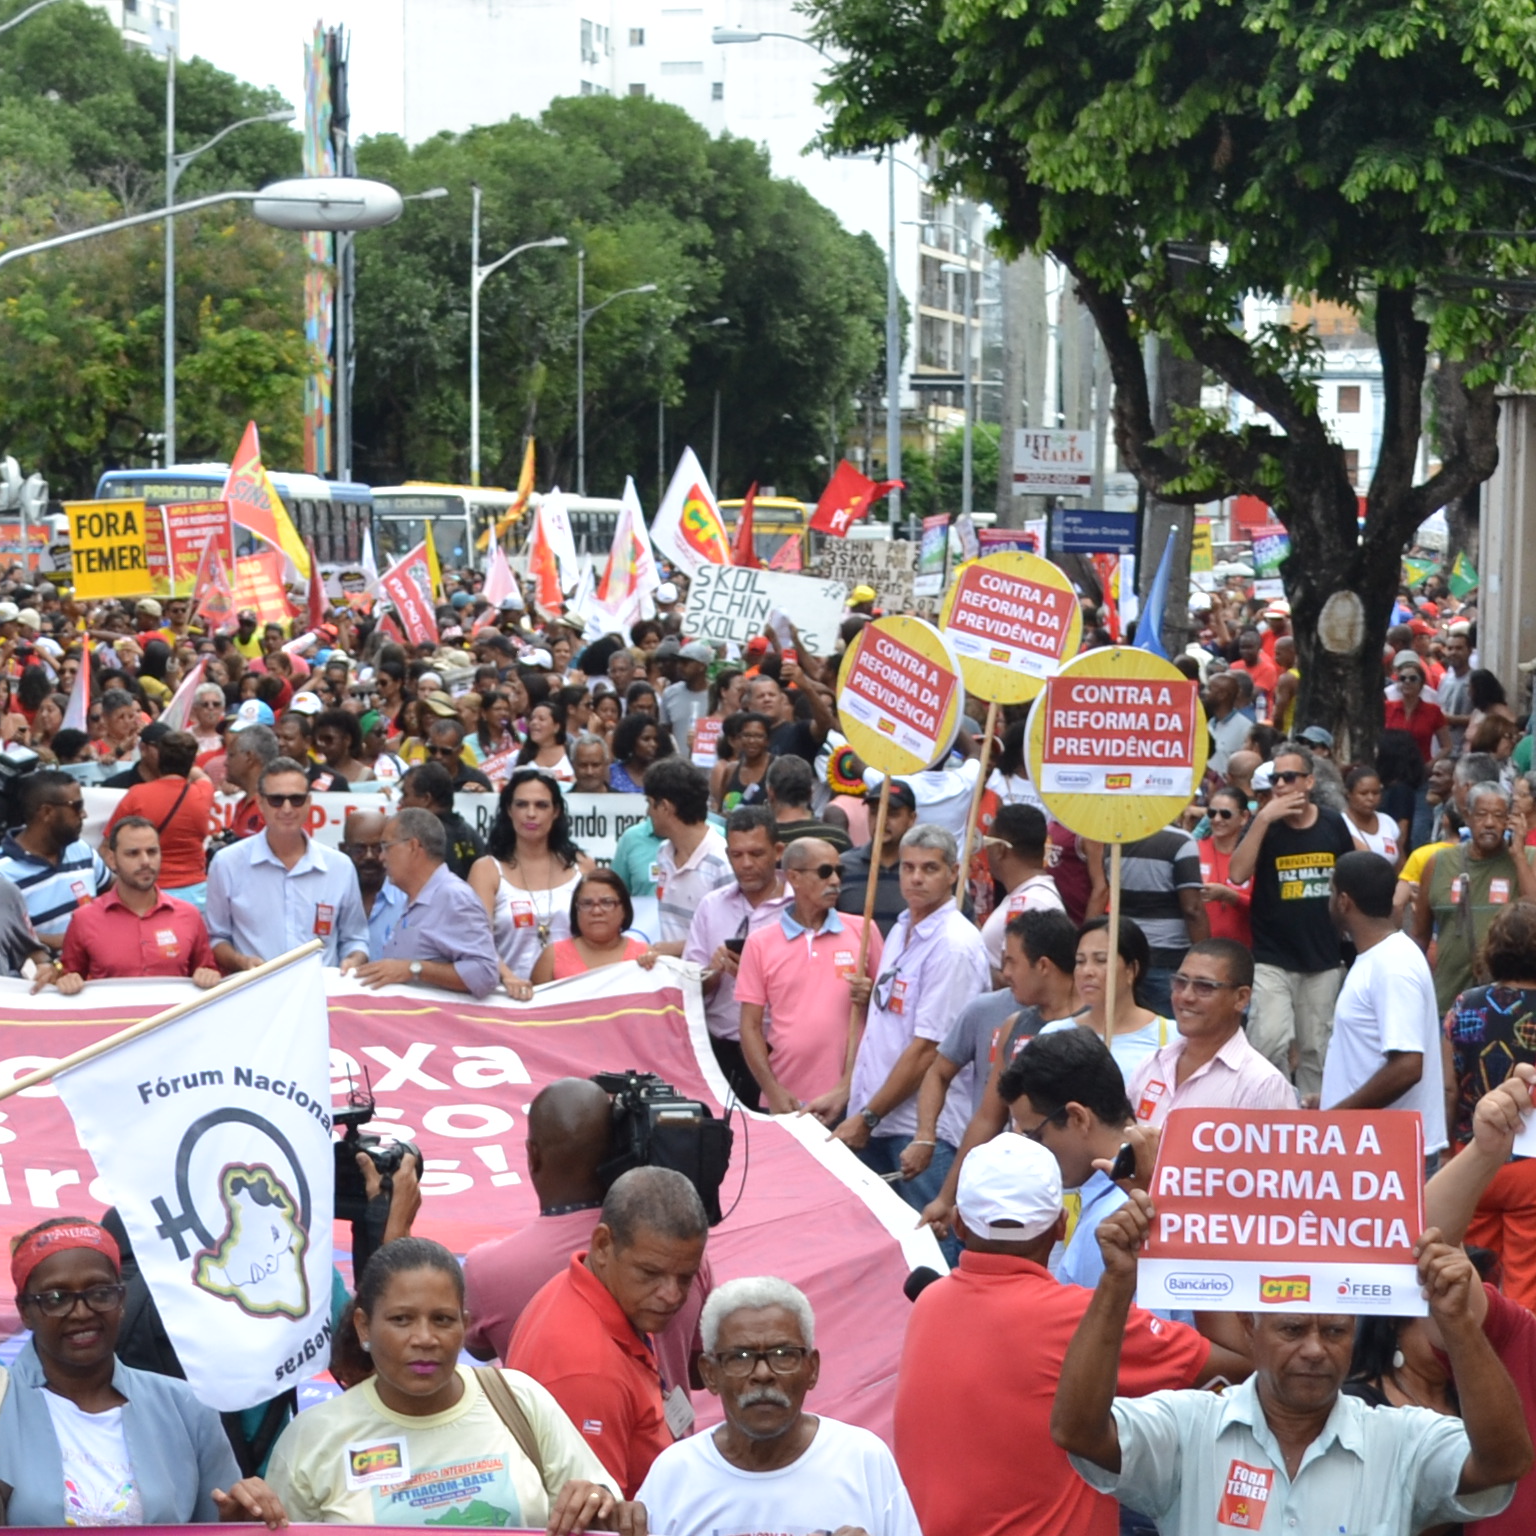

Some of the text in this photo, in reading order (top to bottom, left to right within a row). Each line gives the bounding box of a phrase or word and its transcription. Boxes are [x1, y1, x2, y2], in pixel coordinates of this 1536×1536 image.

[76, 511, 138, 539] FORA
[74, 543, 147, 574] TEMER!
[695, 565, 767, 595] SKOL
[979, 574, 1056, 608] CONTRA A
[689, 591, 771, 620] SCHIN
[961, 589, 1034, 623] REFORMA
[1036, 611, 1059, 630] DA
[956, 610, 1056, 652] PREVIDÊNCIA
[876, 638, 938, 686] CONTRA A
[858, 651, 940, 710] REFORMA DA
[1071, 683, 1172, 706] CONTRA A
[852, 671, 935, 732] PREVIDÊNCIA
[1053, 711, 1183, 732] REFORMA DA
[1052, 734, 1184, 760] PREVIDÊNCIA
[137, 1066, 224, 1105] Fórum
[1191, 1121, 1381, 1155] CONTRA A
[1158, 1166, 1405, 1201] REFORMA DA
[1159, 1209, 1411, 1248] PREVIDÊNCIA
[1168, 1276, 1392, 1298] Bancários CTB FEEB
[353, 1449, 399, 1470] CTB
[1227, 1480, 1268, 1501] TEMER
[1232, 1465, 1266, 1486] FORA
